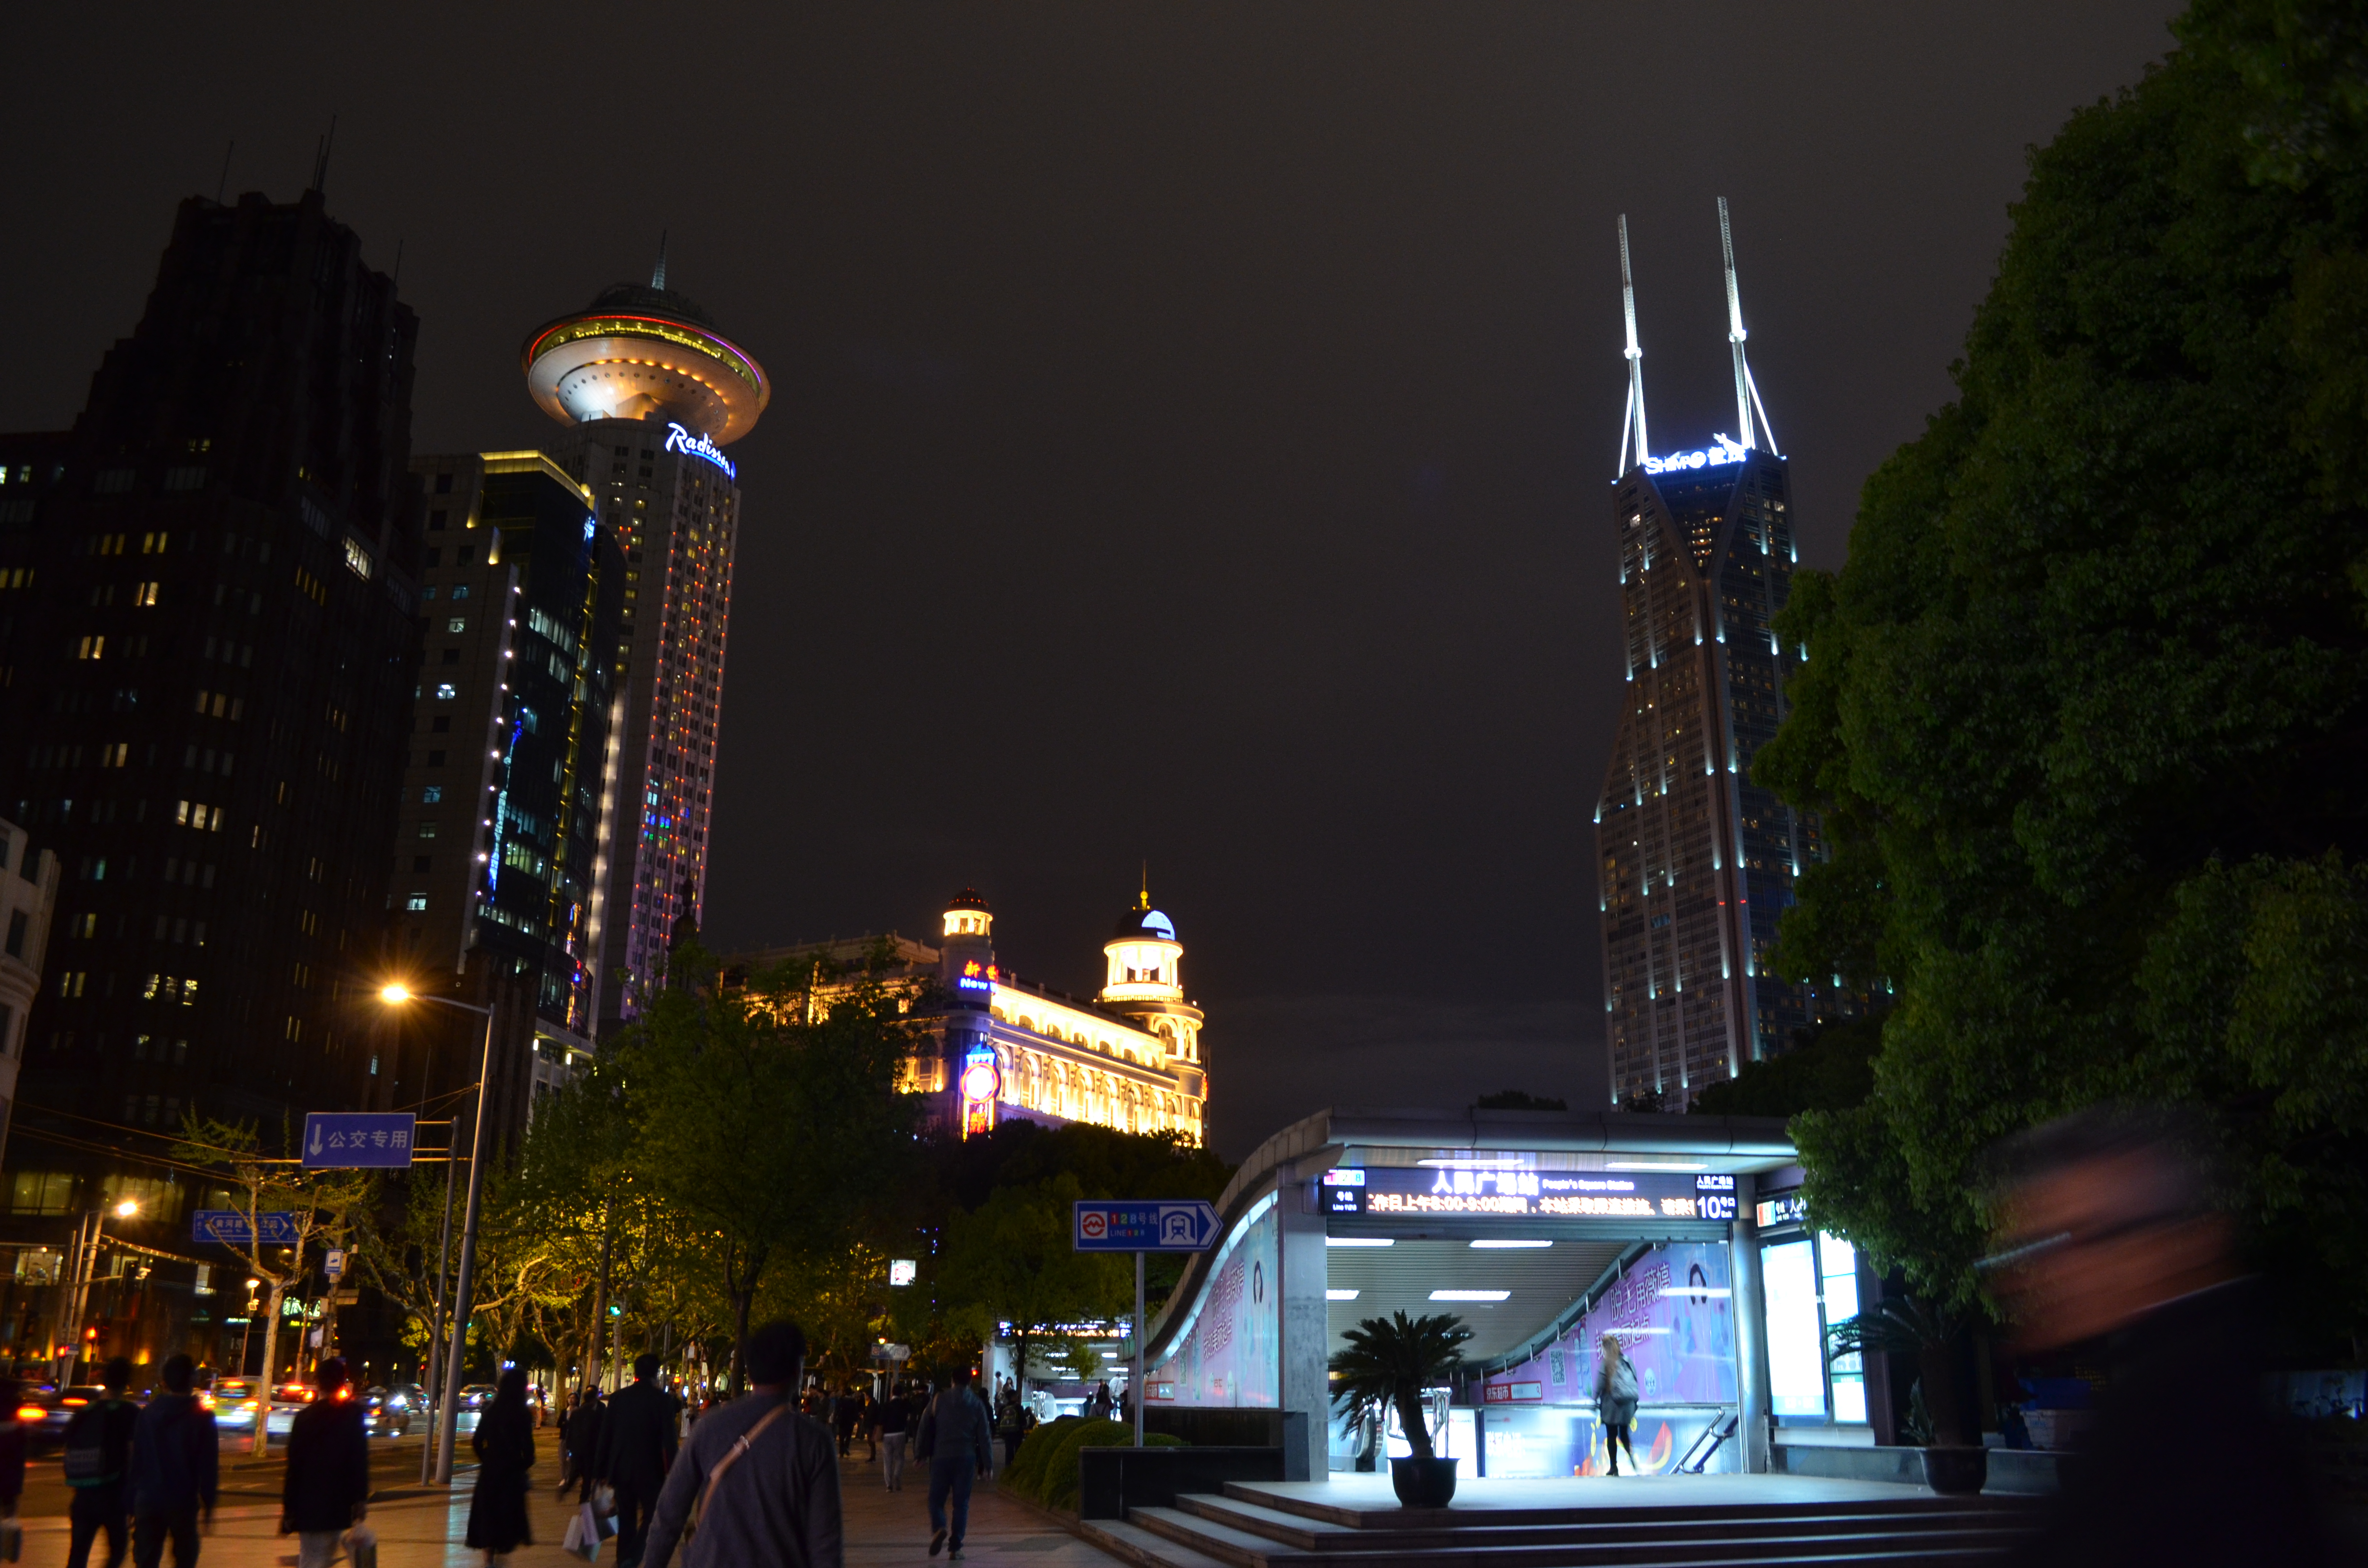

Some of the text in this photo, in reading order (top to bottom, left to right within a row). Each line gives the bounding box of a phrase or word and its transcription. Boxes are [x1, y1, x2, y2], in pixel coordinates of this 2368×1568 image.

[666, 423, 730, 476] Radisson
[964, 960, 998, 983] 新世
[960, 978, 987, 990] New
[329, 1130, 407, 1148] 公交专用
[1431, 1170, 1539, 1196] 人民广场站
[1697, 1196, 1721, 1219] 10
[1610, 1262, 1671, 1322] 脱毛用薇婷
[1596, 1315, 1651, 1360] 我美丽起点
[1486, 1385, 1509, 1400] 京东超市
